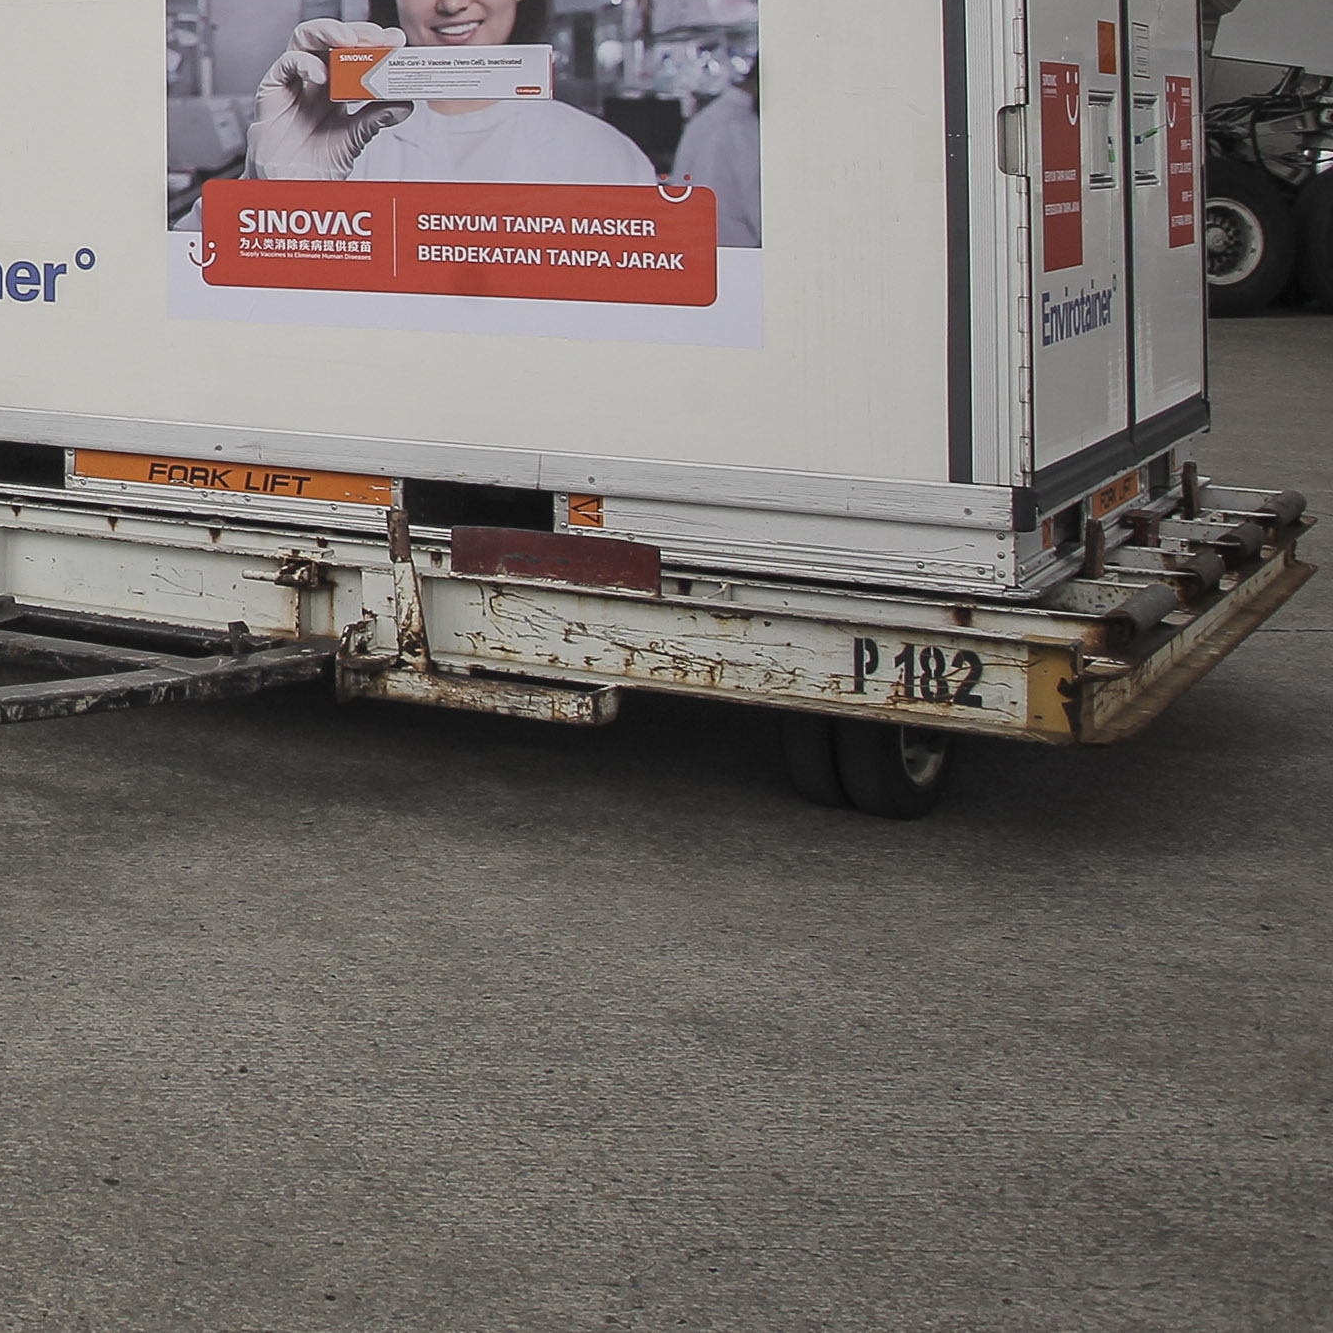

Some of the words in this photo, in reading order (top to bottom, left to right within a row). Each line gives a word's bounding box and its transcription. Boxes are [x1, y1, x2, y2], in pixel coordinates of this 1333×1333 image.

[339, 54, 374, 62] SINOVAC
[238, 209, 372, 236] SINOVAC
[417, 214, 497, 232] SENYUM
[502, 216, 566, 234] TANPA
[571, 218, 656, 237] MASKER
[240, 250, 260, 258] Supply
[418, 245, 541, 265] BERDEKATAN
[546, 249, 612, 268] TANPA
[616, 251, 685, 270] JARAK
[147, 462, 231, 492] FORK
[243, 471, 312, 498] LIFT
[853, 636, 880, 696] P
[893, 642, 983, 708] 182
